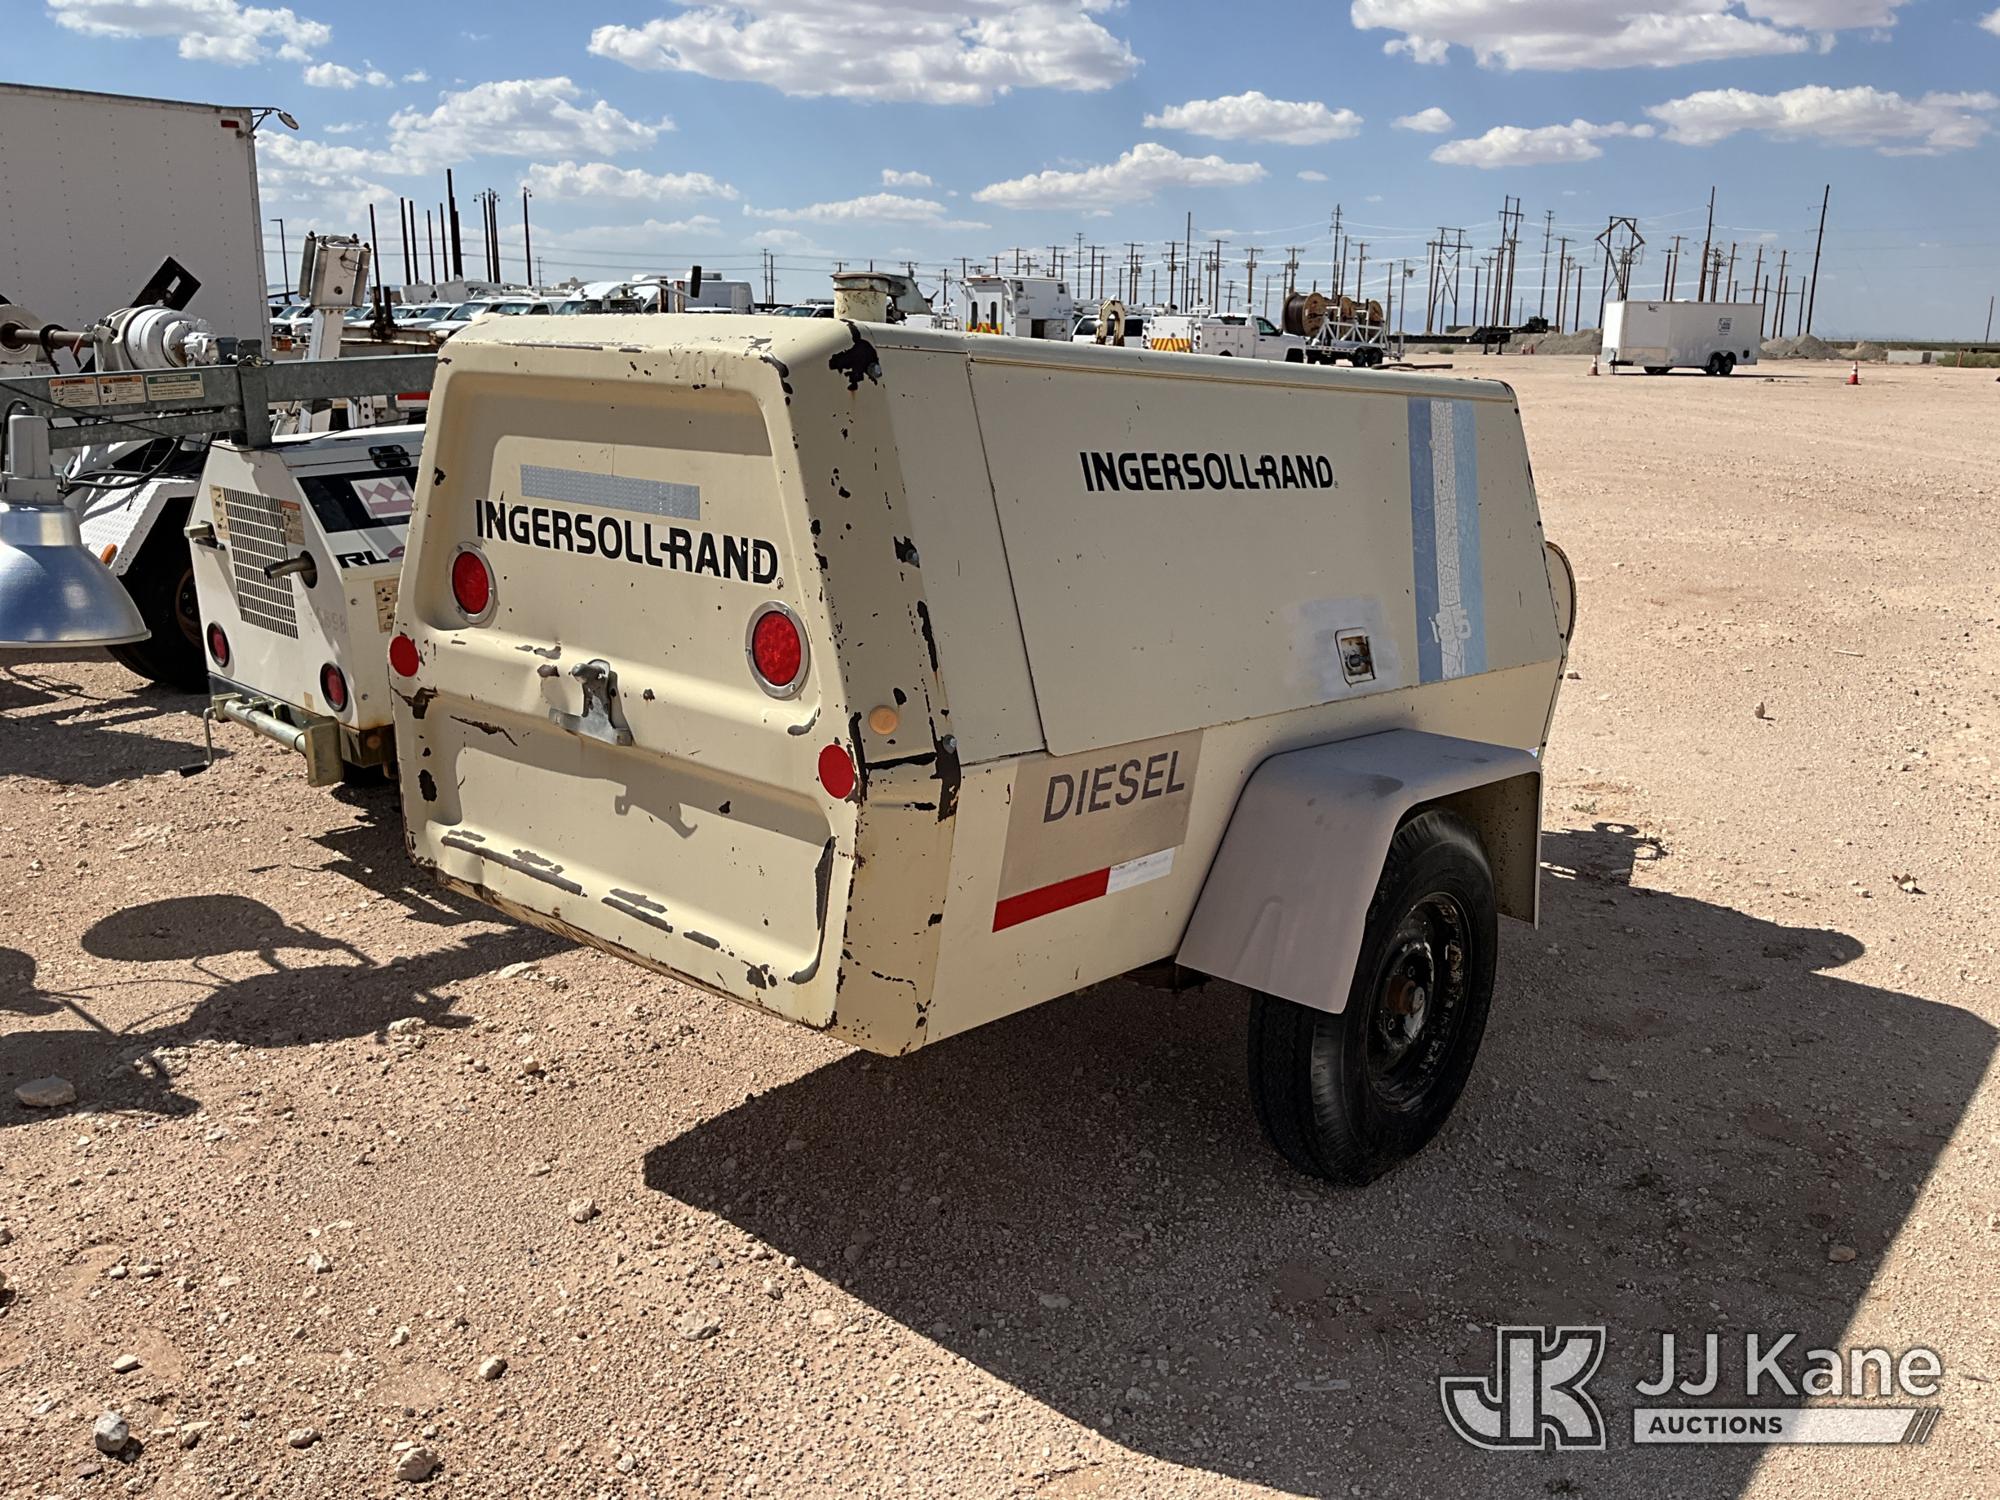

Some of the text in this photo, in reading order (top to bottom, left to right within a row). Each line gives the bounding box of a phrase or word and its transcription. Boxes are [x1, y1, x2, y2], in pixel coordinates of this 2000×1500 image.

[1080, 451, 1334, 491] INGERSOLL-RAND
[475, 498, 780, 584] INGERSOLL-RAND
[1043, 750, 1185, 823] DIESEL
